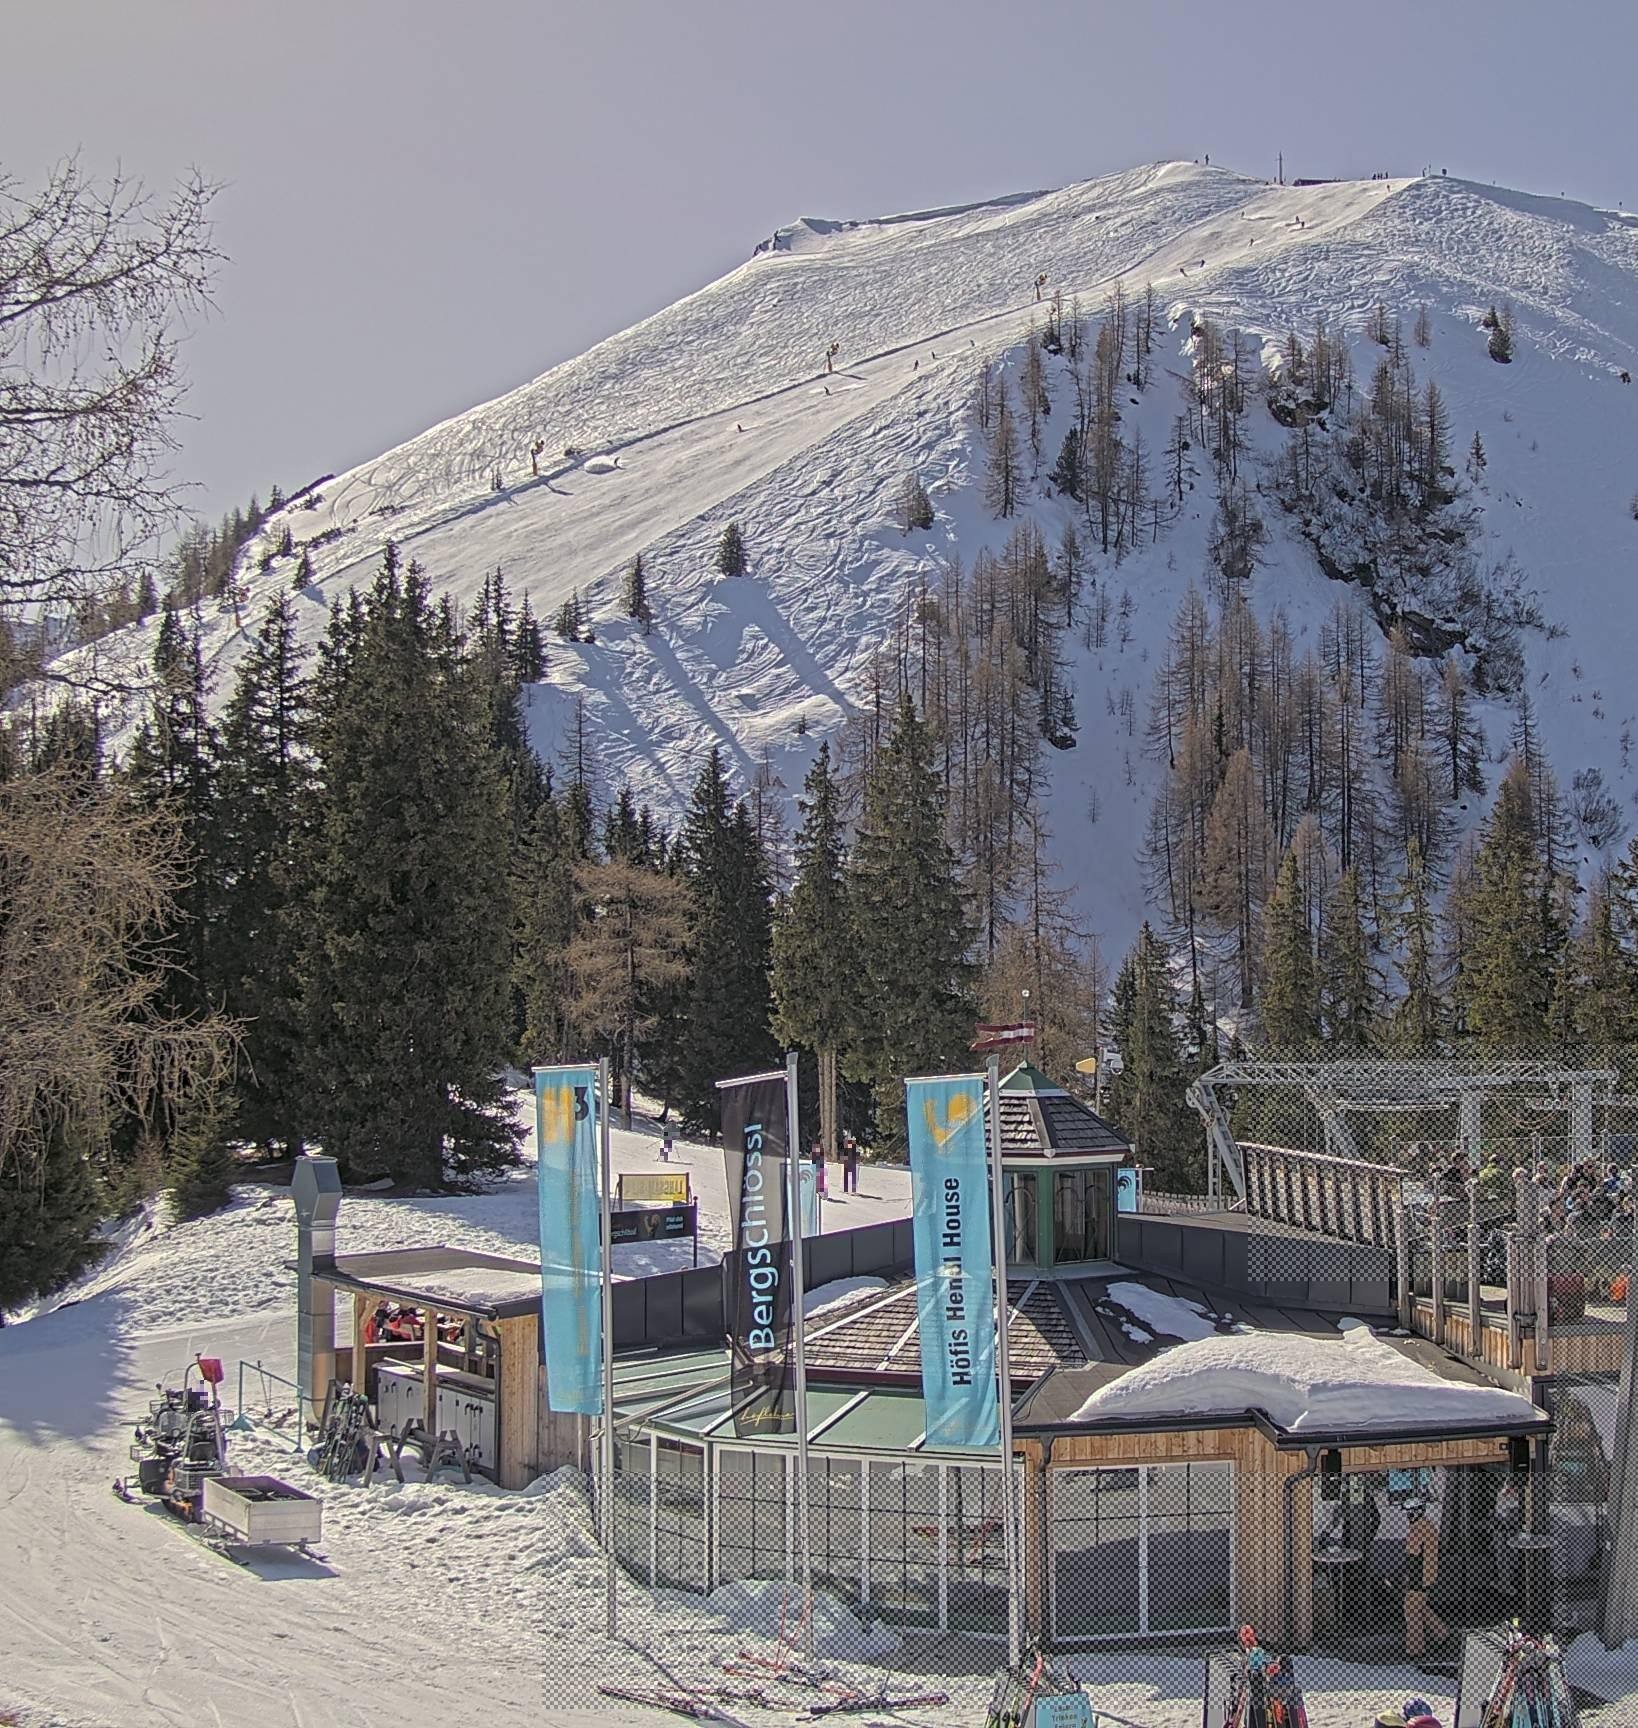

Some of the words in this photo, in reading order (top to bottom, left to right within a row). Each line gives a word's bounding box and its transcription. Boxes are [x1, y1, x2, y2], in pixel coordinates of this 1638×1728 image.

[742, 1122, 778, 1350] Bergschlössl
[942, 1177, 962, 1248] House
[948, 1328, 972, 1386] Höfis
